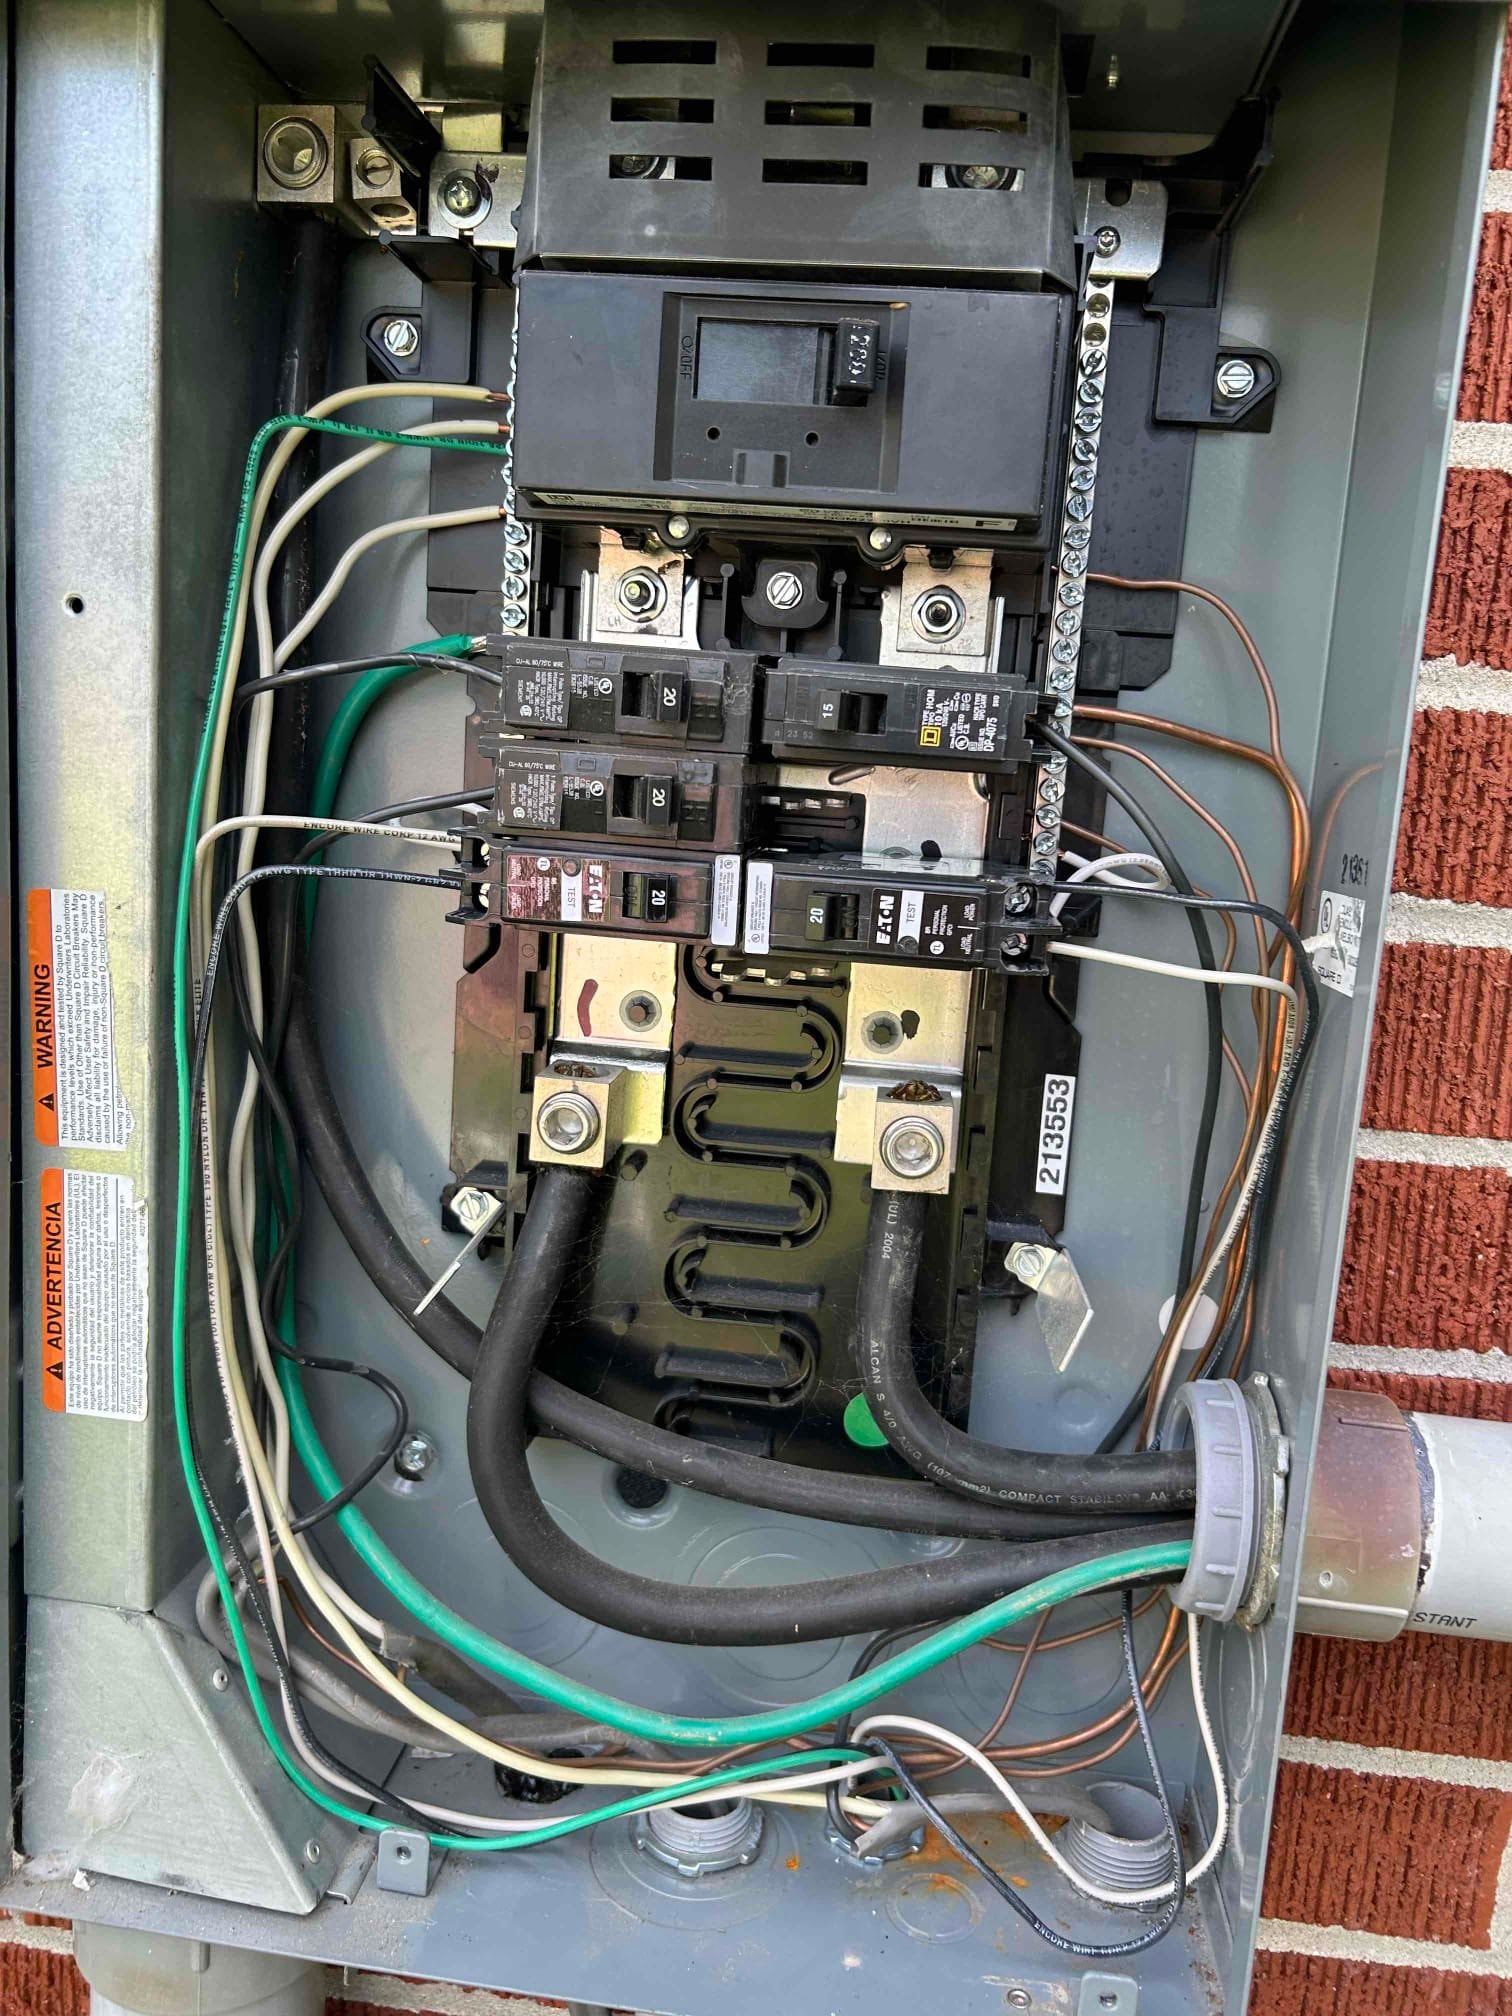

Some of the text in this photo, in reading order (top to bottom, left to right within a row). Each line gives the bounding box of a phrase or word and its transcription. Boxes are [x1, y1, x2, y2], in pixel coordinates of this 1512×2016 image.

[663, 687, 677, 707] 20
[822, 703, 834, 718] 15
[925, 689, 935, 709] HOM
[935, 703, 943, 726] 10 kA
[984, 717, 998, 751] DP-4075
[653, 788, 666, 807] 20
[568, 887, 576, 908] TEST
[651, 889, 666, 906] 20
[81, 904, 89, 934] Square
[809, 907, 824, 924] 20
[906, 902, 916, 924] TEST
[932, 909, 940, 934] PERSONAL
[939, 905, 948, 935] PROTECTION
[89, 895, 98, 966] non-performance
[56, 944, 64, 973] Square
[75, 992, 83, 1021] Square
[83, 981, 91, 1006] Impair
[100, 975, 109, 1022] non-Square
[34, 964, 53, 1069] WARNING
[92, 1008, 100, 1043] damage,
[58, 1032, 67, 1068] designed
[84, 1027, 92, 1052] Safety
[93, 1062, 101, 1089] liability
[60, 1080, 68, 1120] equipment
[68, 1091, 77, 1140] performance
[86, 1103, 94, 1142] Adversely
[115, 1112, 124, 1144] Allowing
[1039, 1077, 1071, 1186] 213553
[888, 1201, 898, 1225] (UL)
[882, 1231, 894, 1260] 2004
[45, 1201, 62, 1351] ADVERTENCIA
[870, 1340, 882, 1385] ALCAN
[927, 1461, 951, 1481] (107
[999, 1489, 1061, 1504] COMPACT
[1413, 1612, 1477, 1629] STANT
